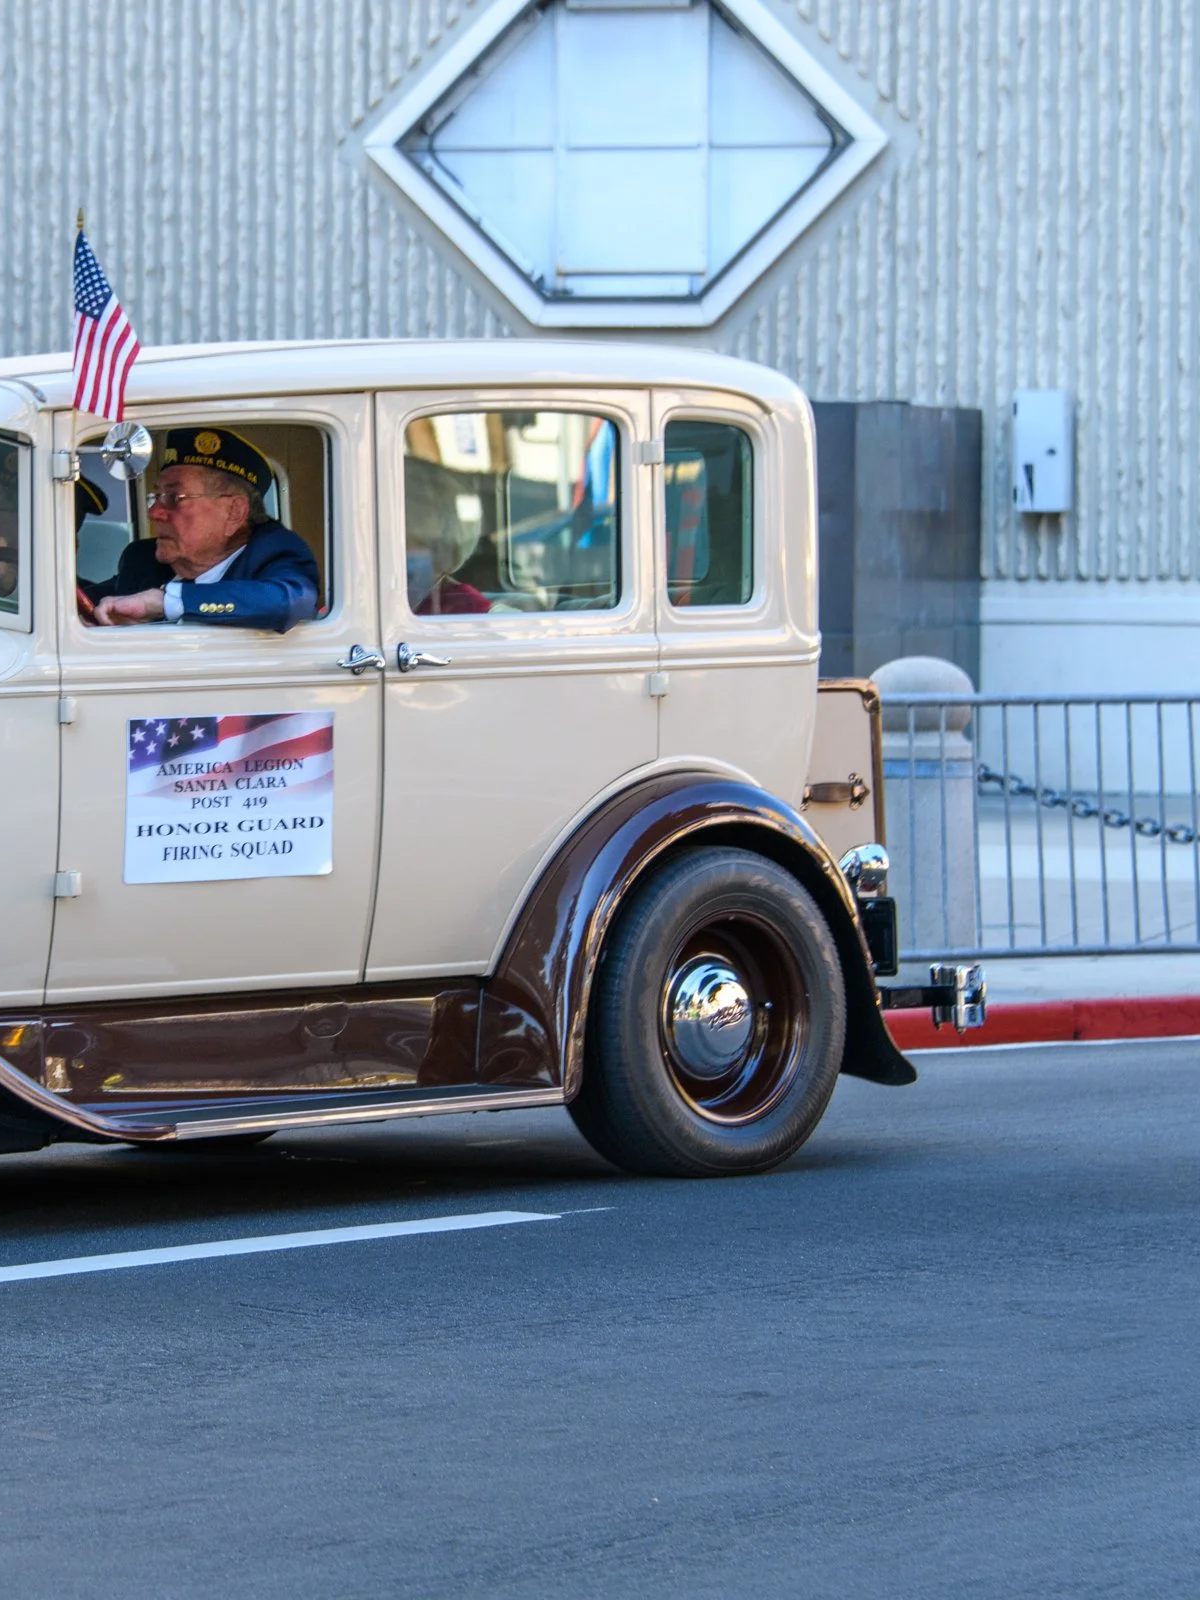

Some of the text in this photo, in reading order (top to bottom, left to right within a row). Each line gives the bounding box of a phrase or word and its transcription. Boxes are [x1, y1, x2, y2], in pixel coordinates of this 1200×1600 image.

[183, 455, 214, 465] SANTA
[156, 757, 305, 777] AMERICA LEGION
[173, 776, 288, 793] SANTA CLARA
[191, 796, 269, 809] POST 419
[135, 816, 325, 837] HONOR GUARD
[162, 839, 294, 861] FIRING SQUAD
